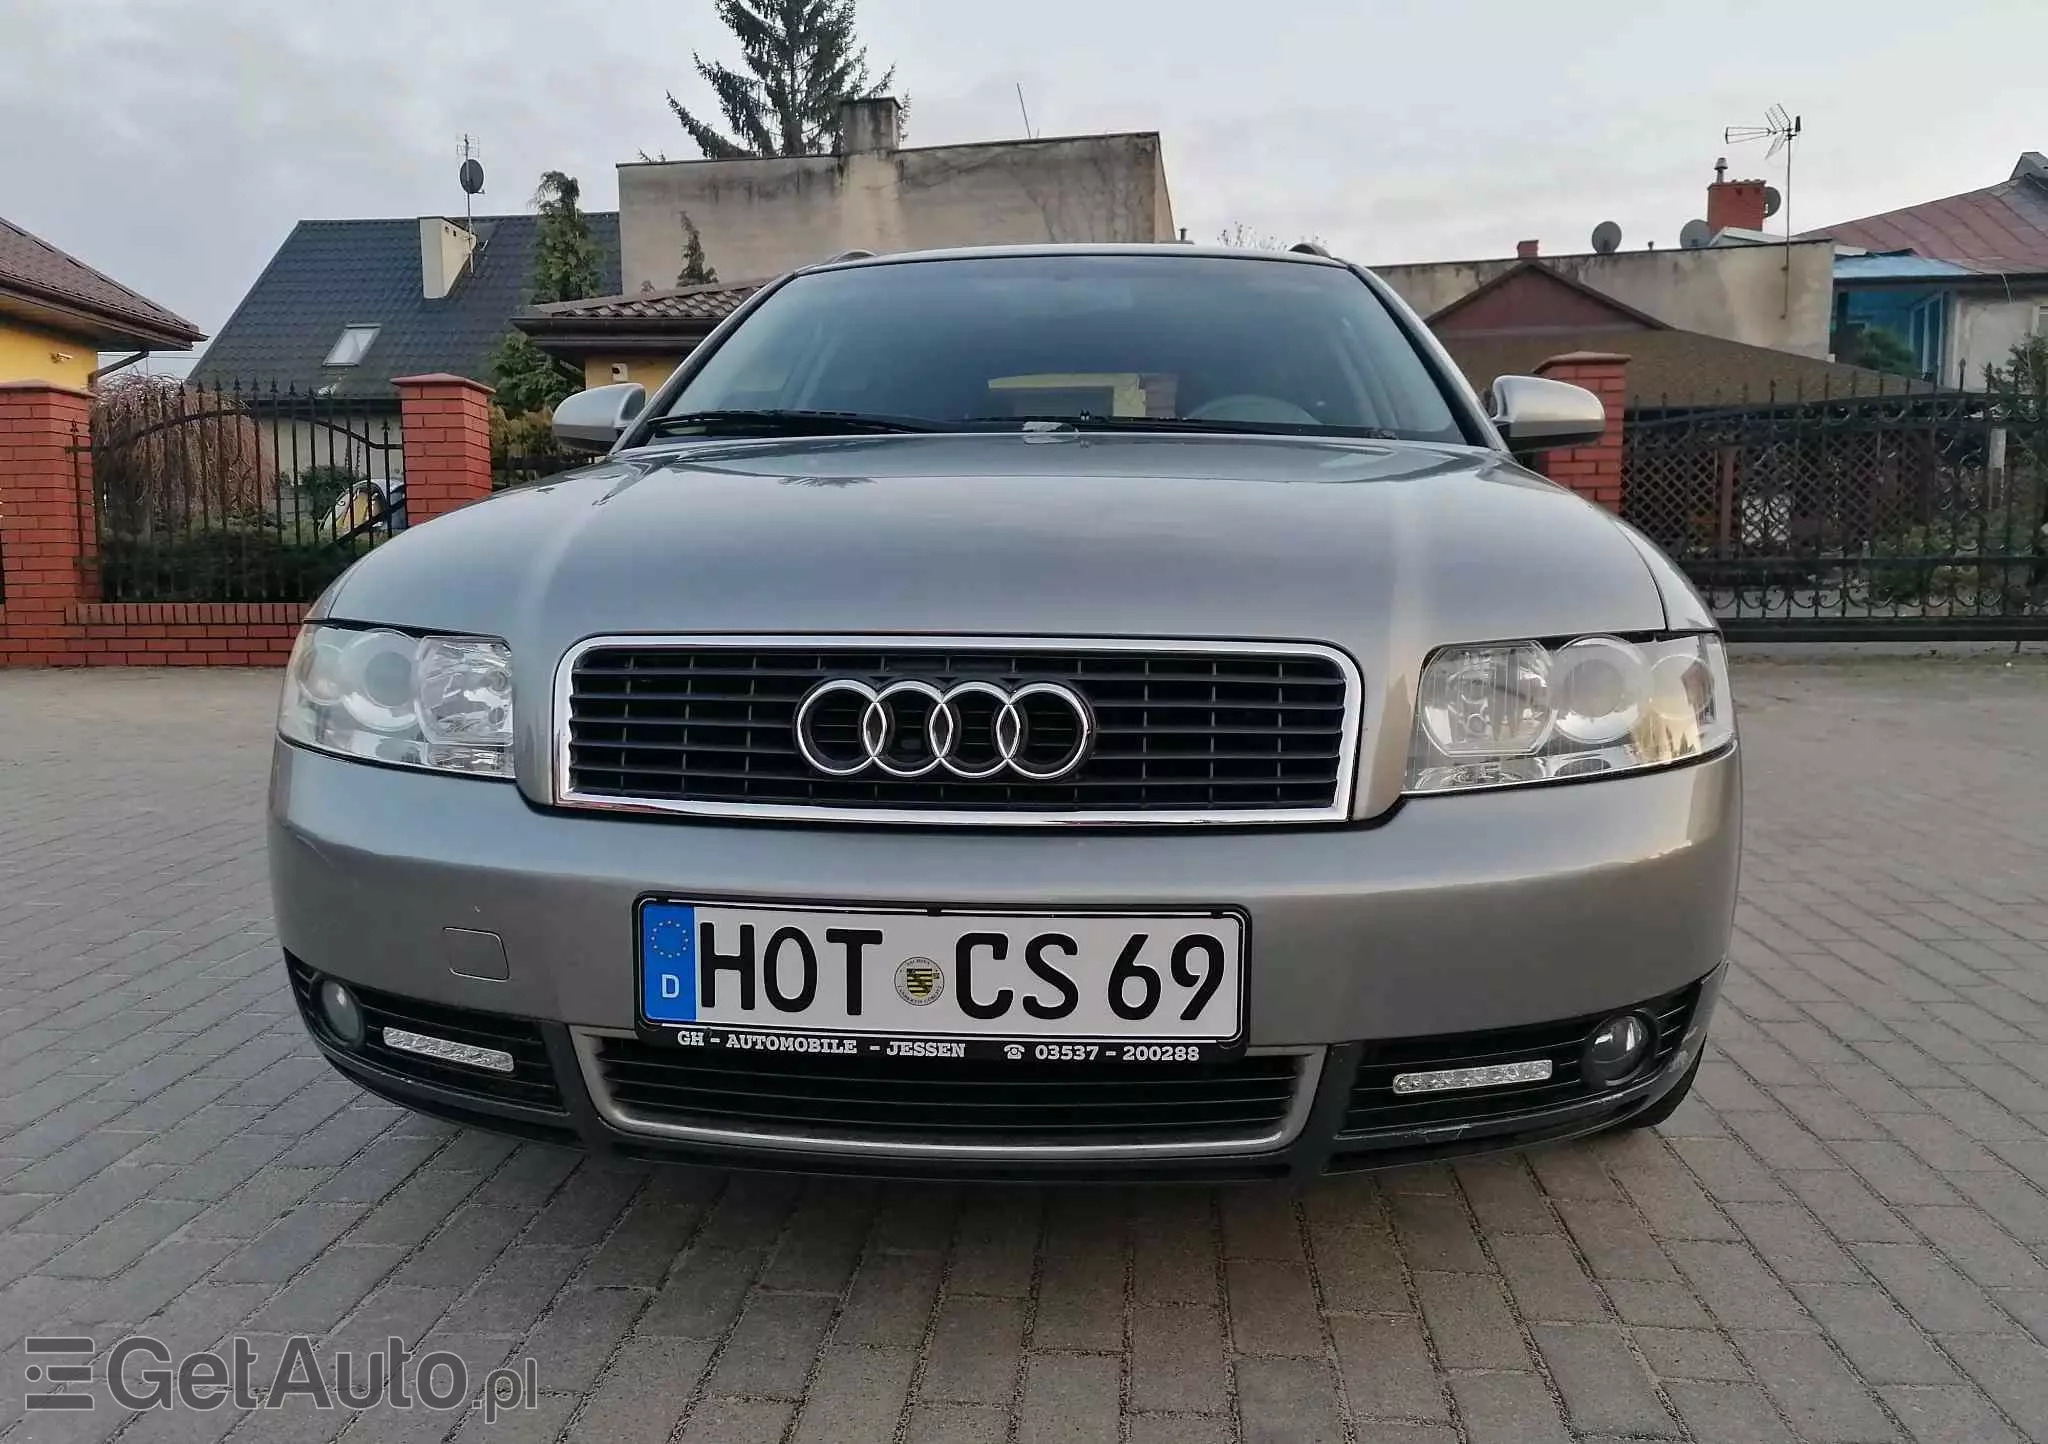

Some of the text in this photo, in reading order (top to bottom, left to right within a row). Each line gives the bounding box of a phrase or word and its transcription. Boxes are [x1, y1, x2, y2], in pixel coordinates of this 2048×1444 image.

[699, 922, 1225, 1021] HOT CS 69
[661, 974, 680, 998] D
[677, 1031, 704, 1046] GH
[726, 1034, 857, 1054] AUTOMOBILE
[886, 1041, 965, 1058] JESSEN
[1035, 1044, 1099, 1061] 03537
[1122, 1045, 1200, 1061] 200288
